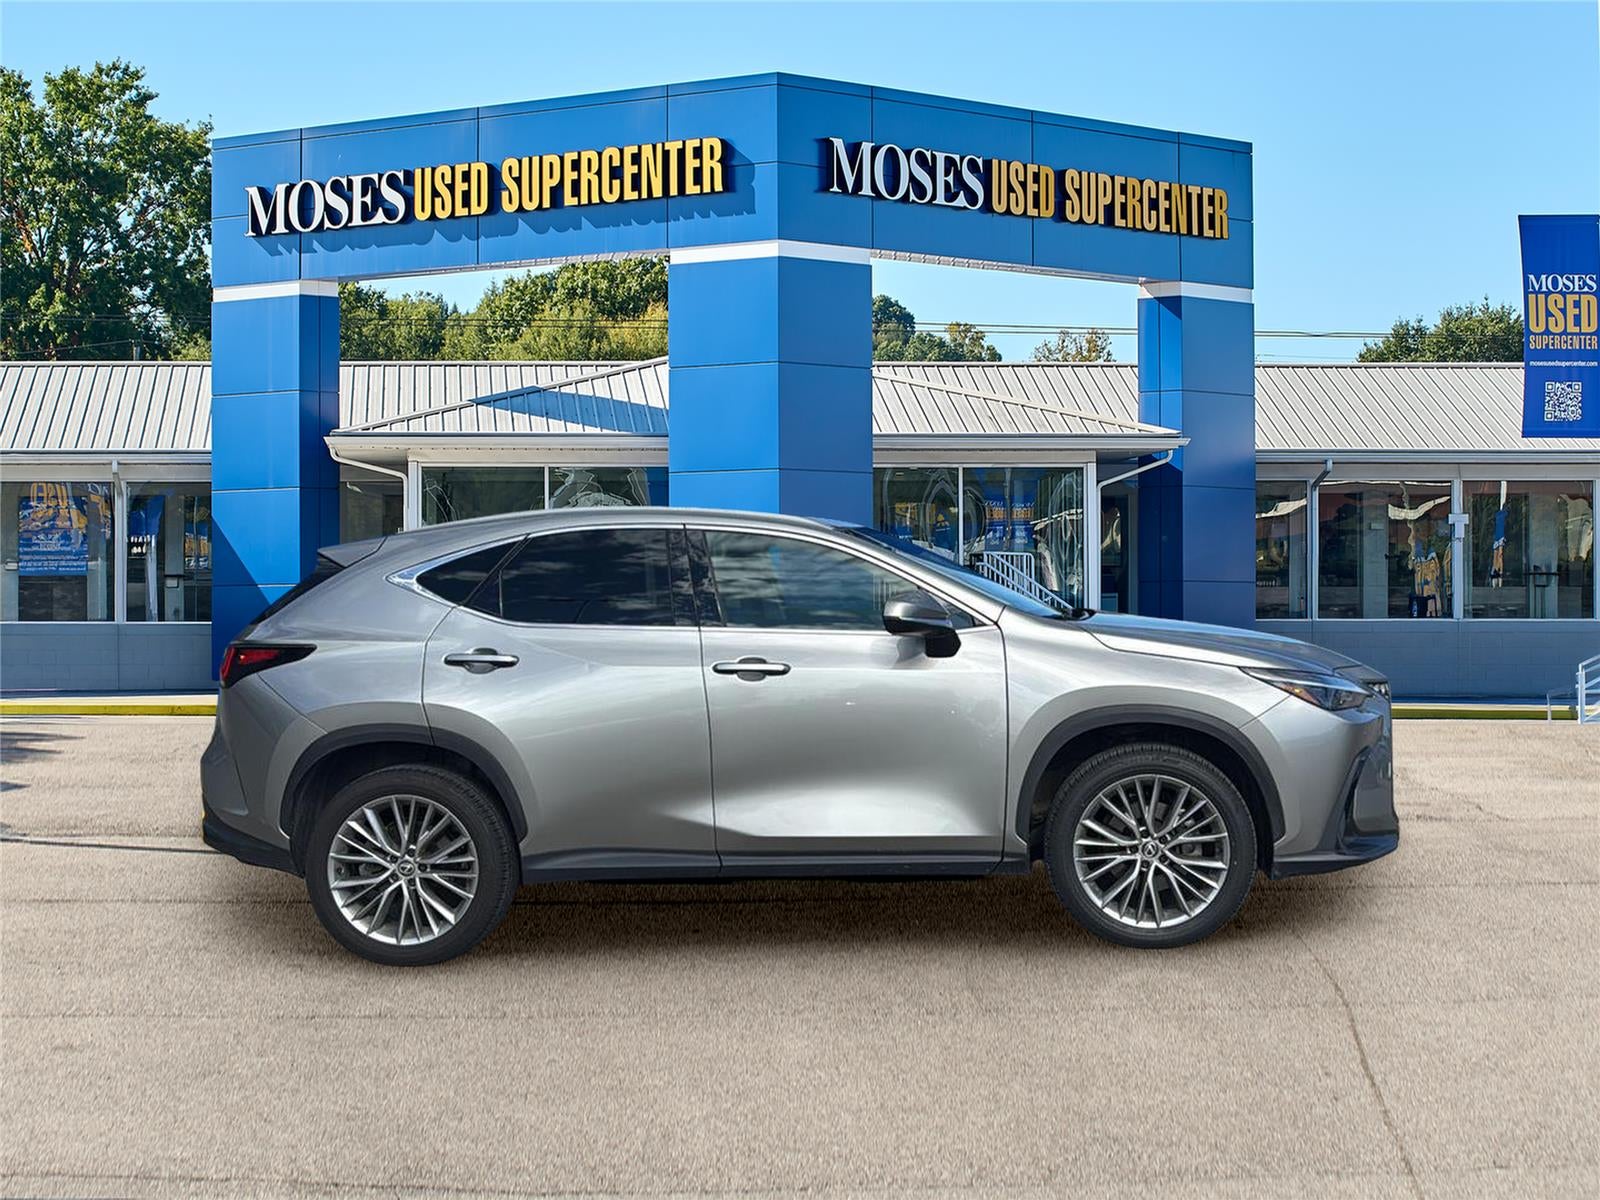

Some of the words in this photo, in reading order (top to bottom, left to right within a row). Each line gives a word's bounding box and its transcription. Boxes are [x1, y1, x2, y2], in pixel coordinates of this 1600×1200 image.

[244, 170, 406, 237] MOSES
[413, 162, 489, 221] USED
[501, 137, 724, 213] SUPERCENTER
[829, 137, 984, 210] MOSES
[991, 158, 1056, 218] USED
[1065, 168, 1229, 239] SUPERCENTER
[1528, 274, 1597, 292] MOSES
[1528, 294, 1598, 333] USED
[1529, 335, 1598, 350] SUPERCENTER
